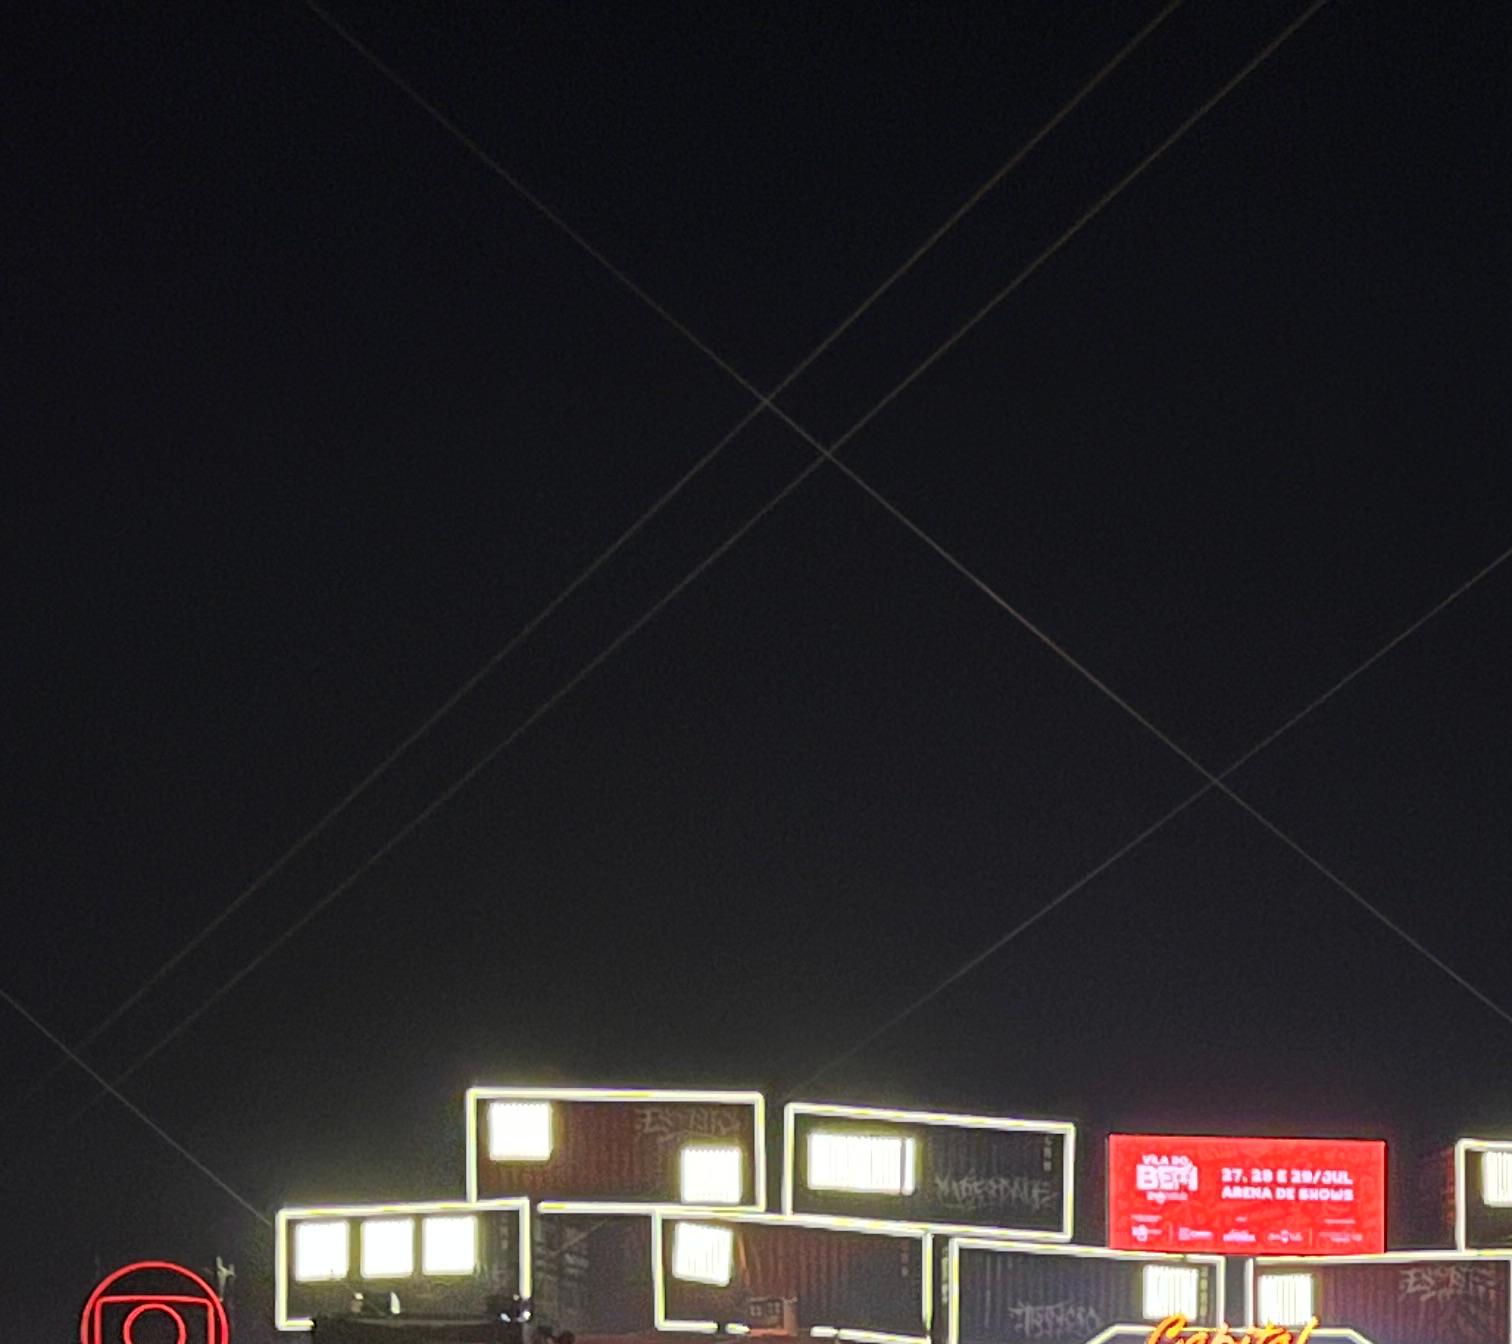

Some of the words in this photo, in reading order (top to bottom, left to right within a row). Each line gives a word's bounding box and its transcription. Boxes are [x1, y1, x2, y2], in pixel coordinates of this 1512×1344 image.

[1221, 1185, 1273, 1200] ARENA
[1275, 1186, 1296, 1200] DE
[1298, 1187, 1354, 1202] SHOWS
